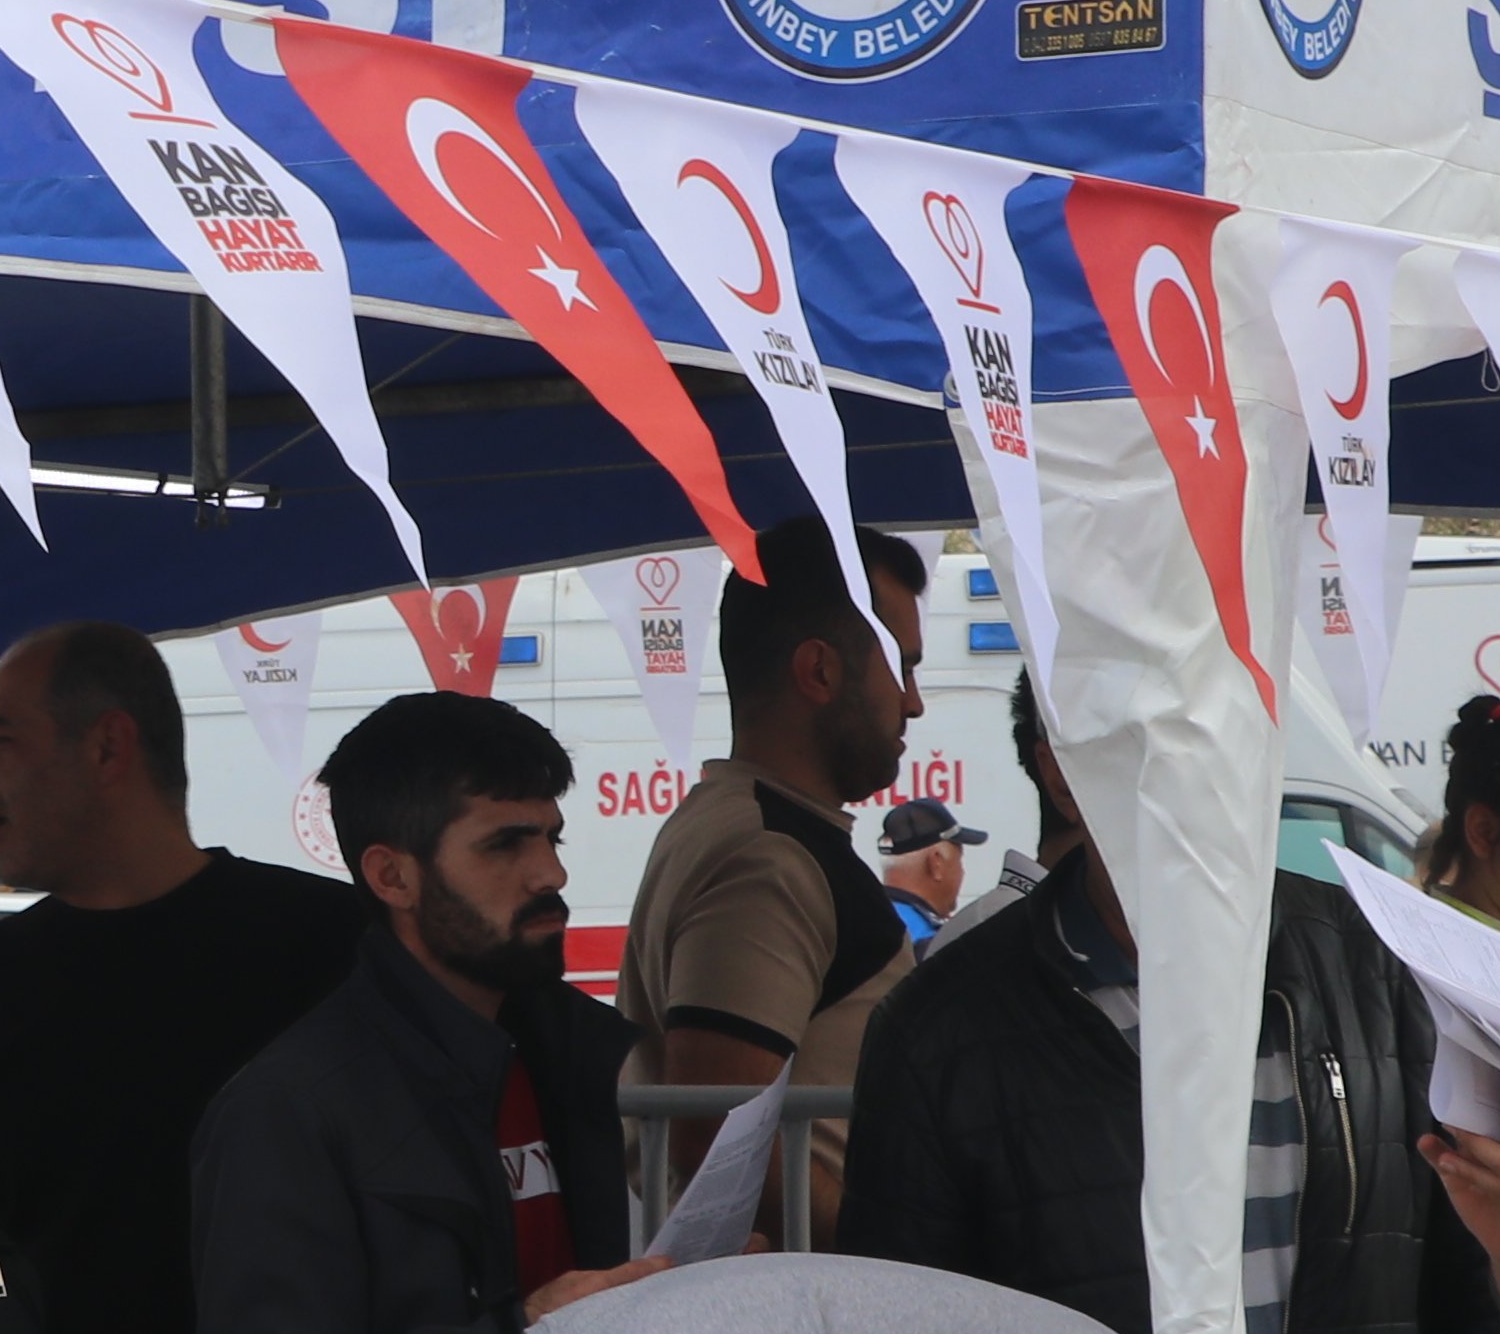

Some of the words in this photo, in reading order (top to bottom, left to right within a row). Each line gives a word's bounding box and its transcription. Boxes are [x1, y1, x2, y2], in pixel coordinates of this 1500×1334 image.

[147, 139, 265, 184] KAN
[196, 218, 306, 251] HAYAT
[216, 251, 325, 274] KURTARIR
[762, 328, 798, 353] TÜRK
[964, 324, 1016, 374] KAN
[752, 351, 824, 396] KIZILAY
[984, 401, 1024, 438] HAYAT
[1328, 455, 1377, 489] KIZILAY
